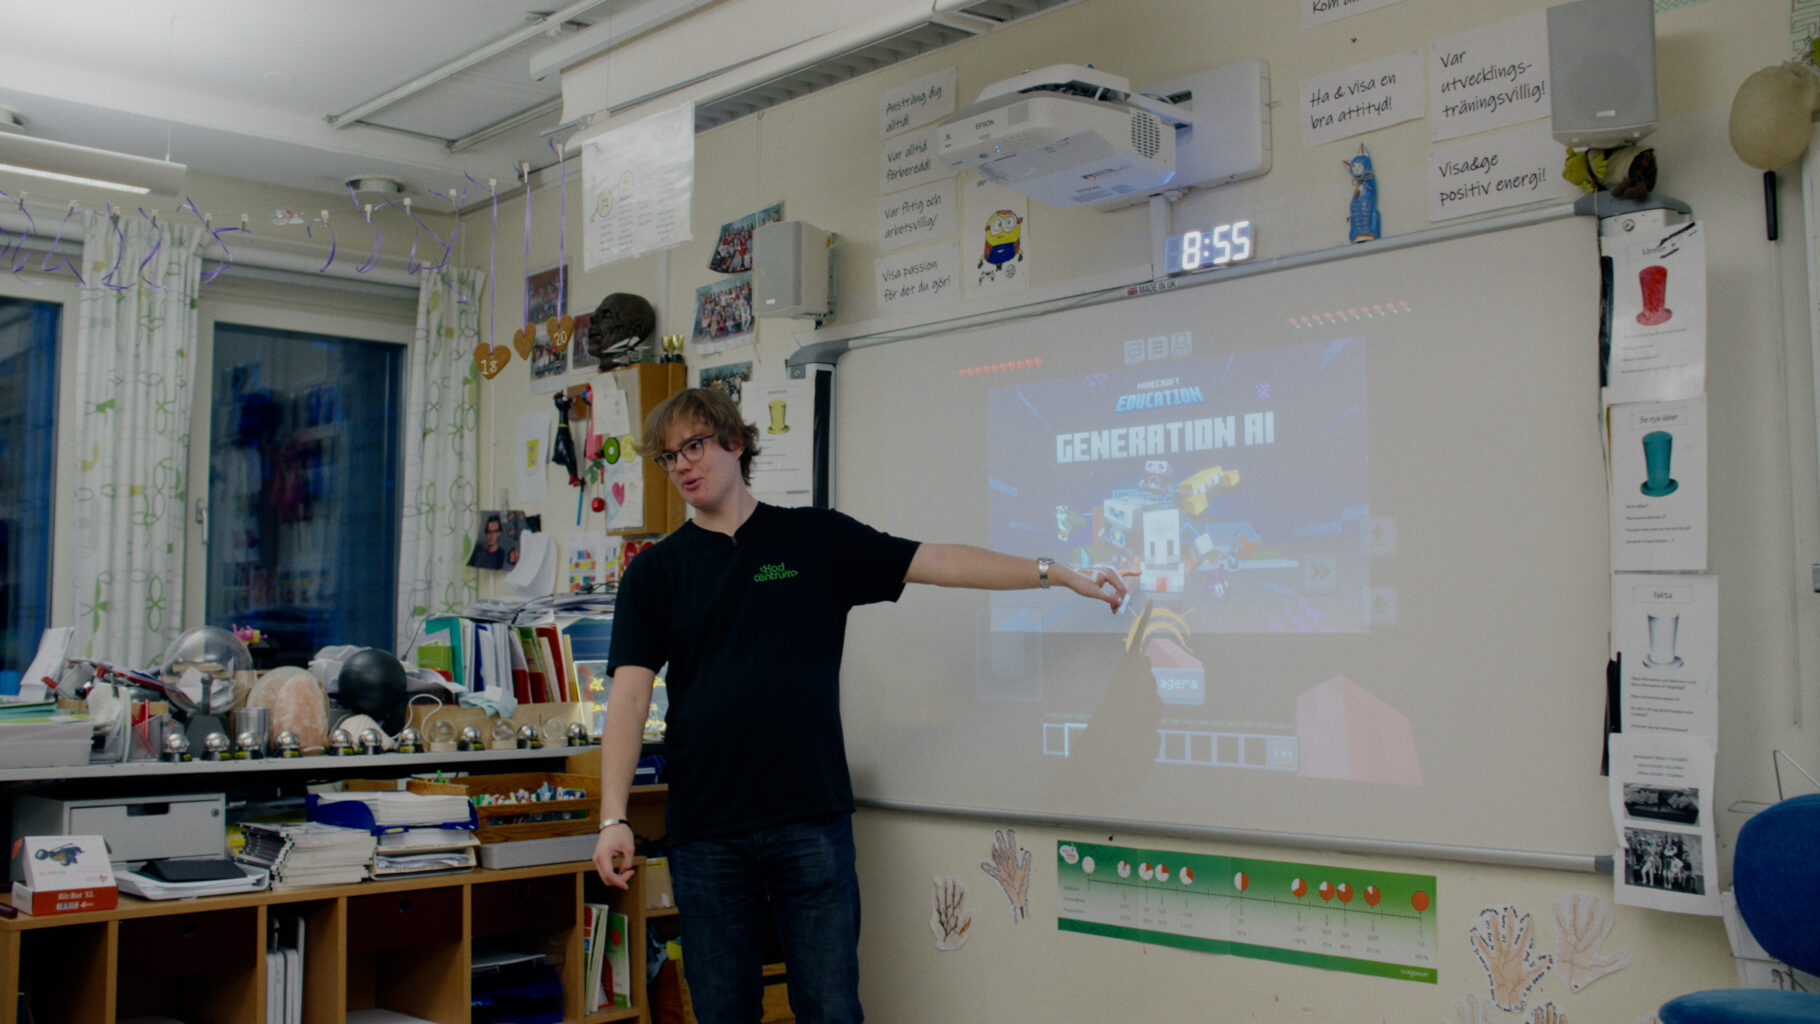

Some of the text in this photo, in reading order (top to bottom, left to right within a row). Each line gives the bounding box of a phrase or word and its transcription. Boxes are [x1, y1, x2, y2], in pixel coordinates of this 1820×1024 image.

[1440, 51, 1466, 68] Var
[1310, 73, 1396, 107] Ha & visa en
[1441, 62, 1532, 93] utvecklings-
[929, 86, 942, 100] dig
[1442, 80, 1546, 118] träningsvillig!
[1310, 95, 1393, 129] bra attityd!
[887, 139, 927, 163] Var alltid
[1439, 154, 1499, 178] Visa&ge
[1440, 167, 1546, 207] positiv energi!
[884, 207, 900, 219] Var
[926, 193, 942, 208] och
[1182, 220, 1250, 270] 8:55
[882, 260, 938, 282] Visa passion
[884, 288, 898, 303] för
[900, 284, 915, 298] det
[918, 280, 929, 293] du
[1139, 280, 1177, 294] MADE IN UK
[553, 330, 568, 346] 20
[480, 359, 499, 375] 18
[1114, 386, 1204, 412] EDUCATION
[1056, 411, 1275, 464] GENERATION AI
